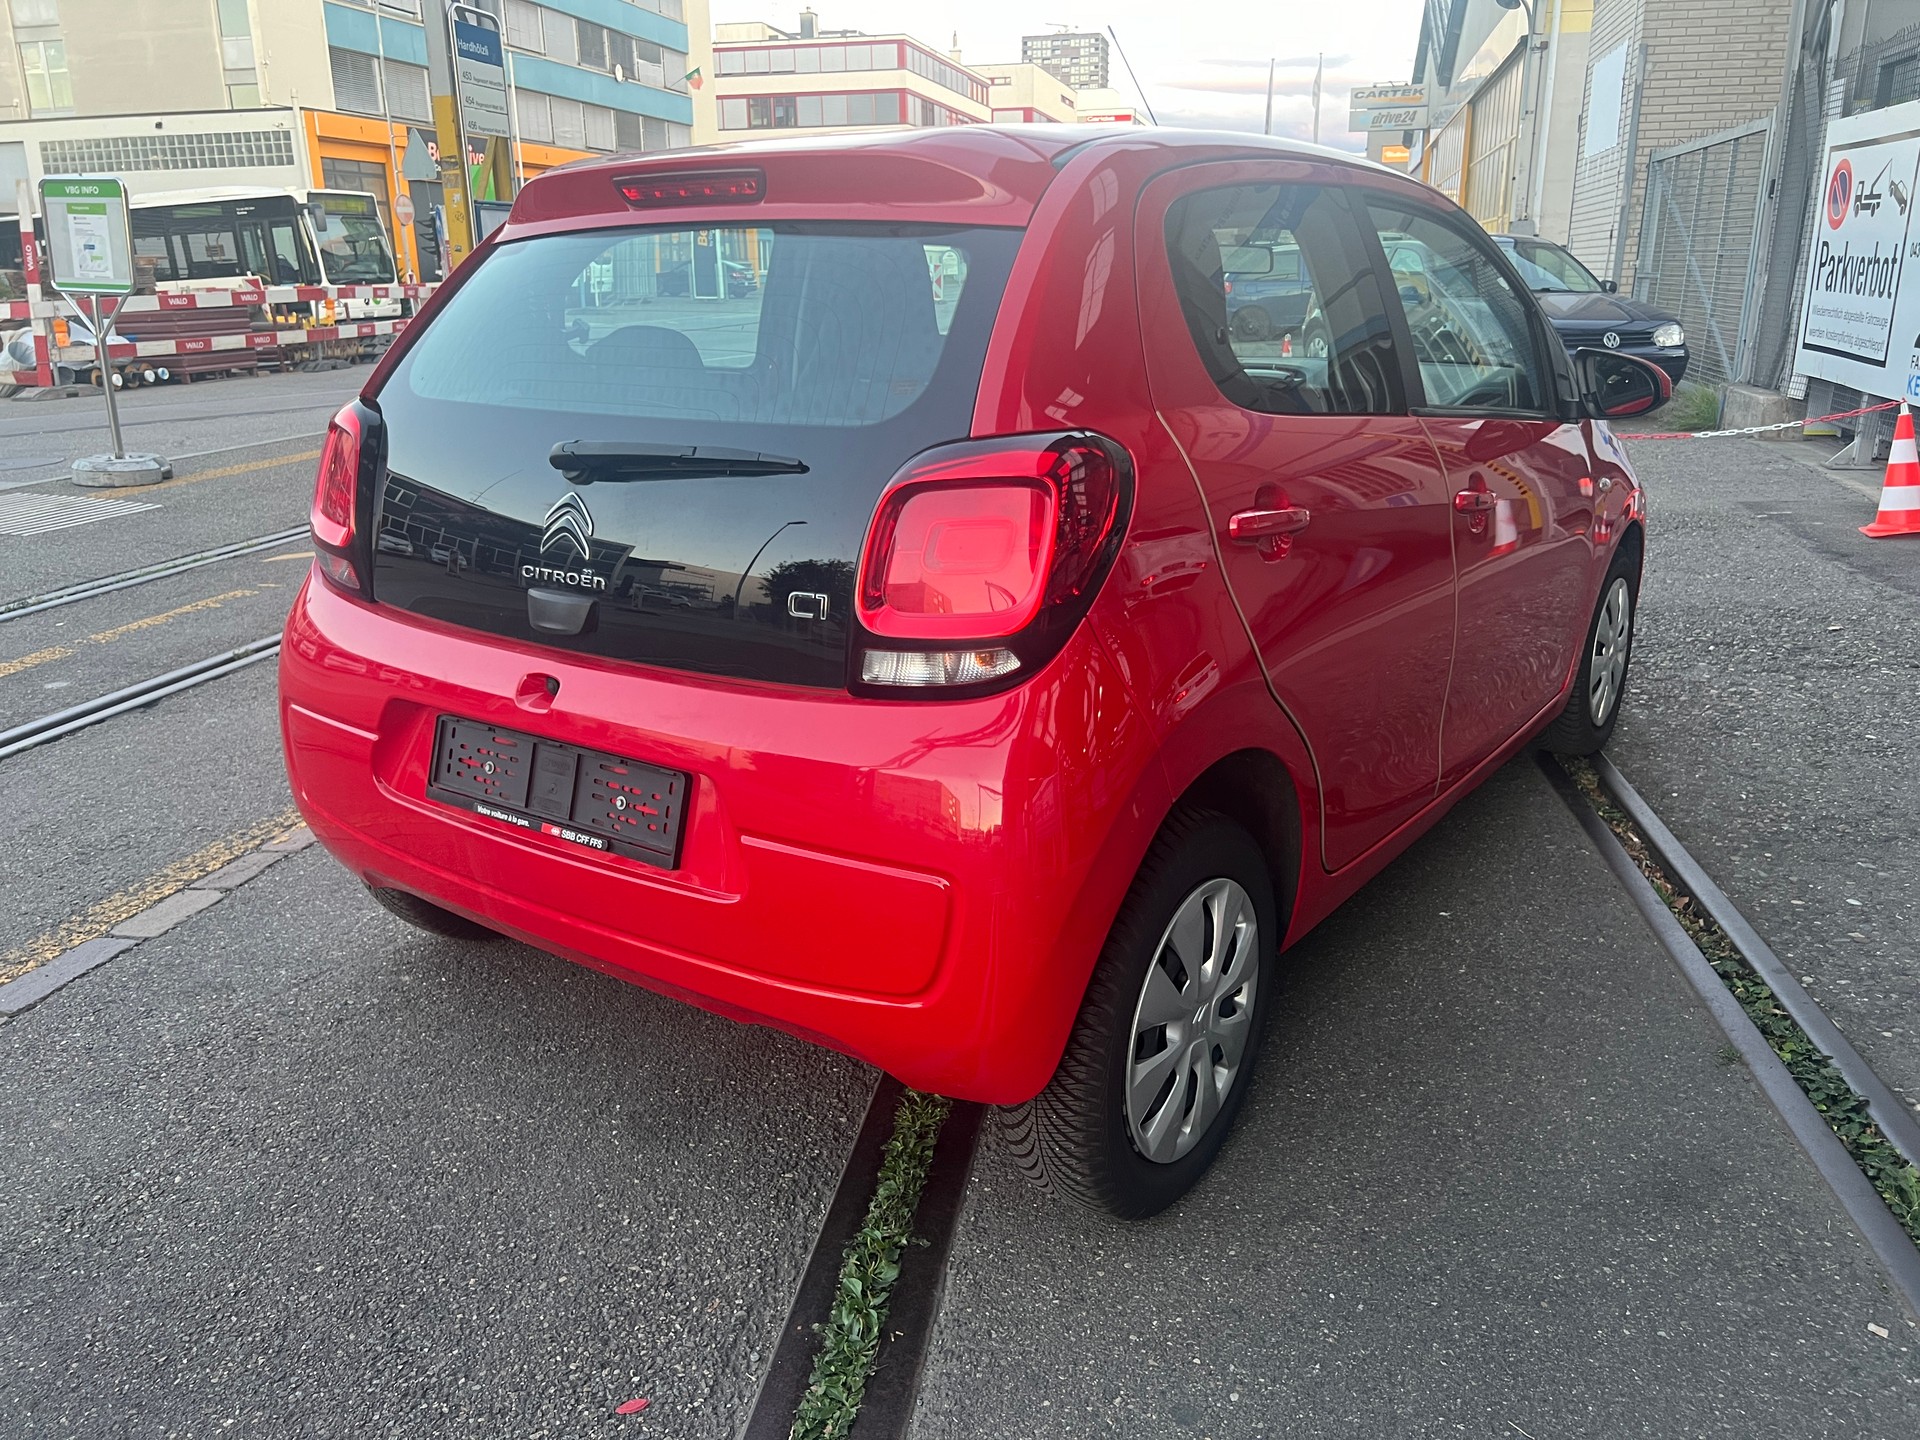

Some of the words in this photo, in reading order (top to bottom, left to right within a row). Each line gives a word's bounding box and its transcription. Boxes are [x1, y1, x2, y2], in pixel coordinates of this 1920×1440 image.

[457, 38, 489, 56] Hardhölzli
[462, 71, 472, 81] 453
[1354, 88, 1426, 99] CARTEK
[65, 186, 80, 195] VBG
[81, 186, 99, 195] INFO
[25, 244, 35, 271] WALO
[1816, 241, 1898, 299] Parkverbot
[168, 297, 188, 306] WALO
[240, 293, 259, 302] WALO
[185, 340, 204, 350] WALO
[254, 335, 271, 344] WALO
[522, 565, 605, 590] CITROËN
[787, 591, 830, 620] C1
[477, 805, 491, 815] Votre
[491, 810, 508, 820] voiture
[561, 829, 576, 841] SBB
[576, 833, 590, 845] CFF
[589, 837, 603, 849] FFS
